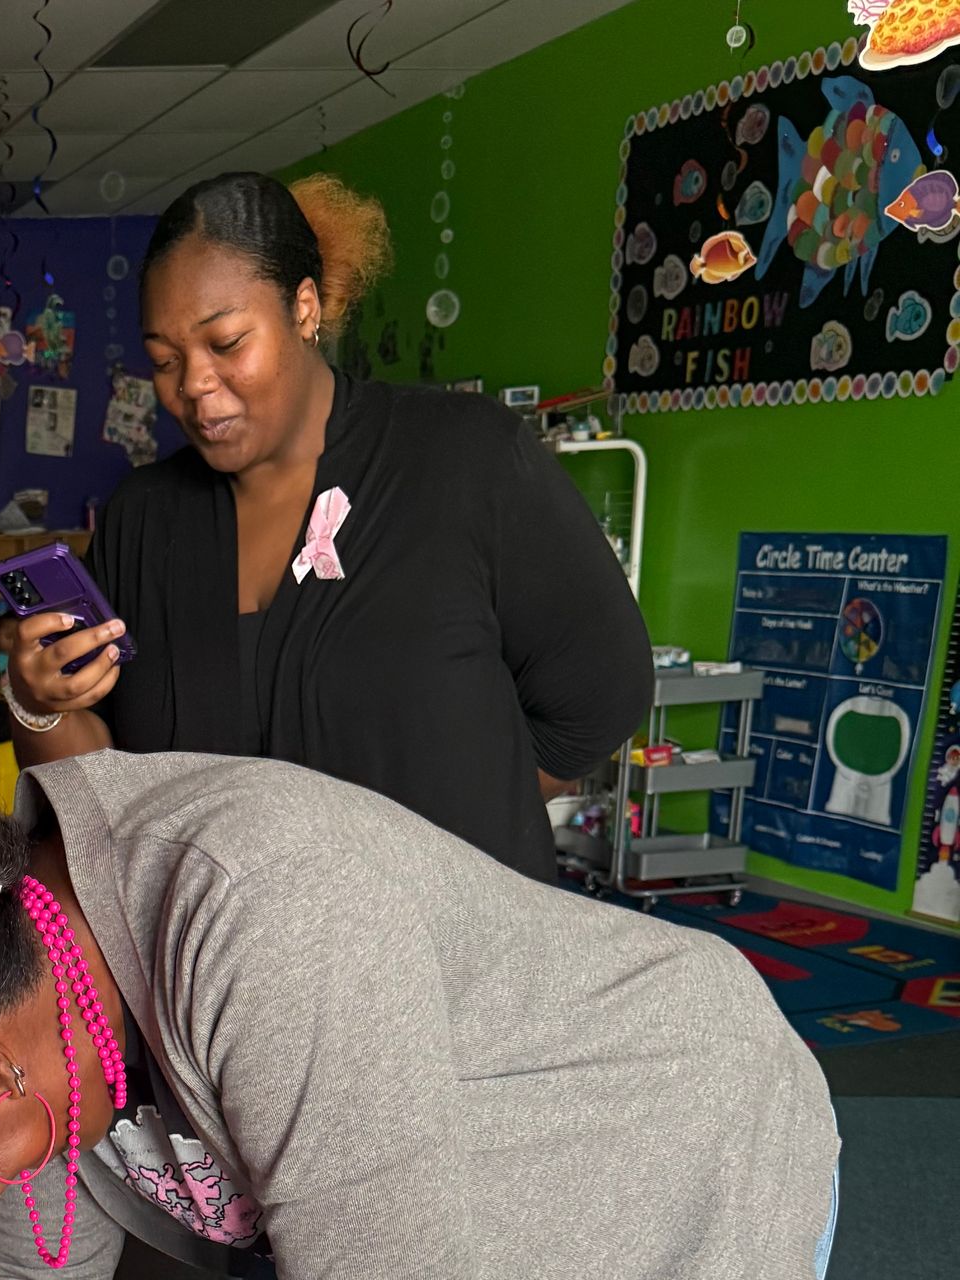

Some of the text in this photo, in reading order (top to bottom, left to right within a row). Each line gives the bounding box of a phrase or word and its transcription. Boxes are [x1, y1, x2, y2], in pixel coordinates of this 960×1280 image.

[661, 291, 788, 341] RAINBOW
[685, 347, 752, 382] FISH
[756, 542, 909, 574] Circle Time Center
